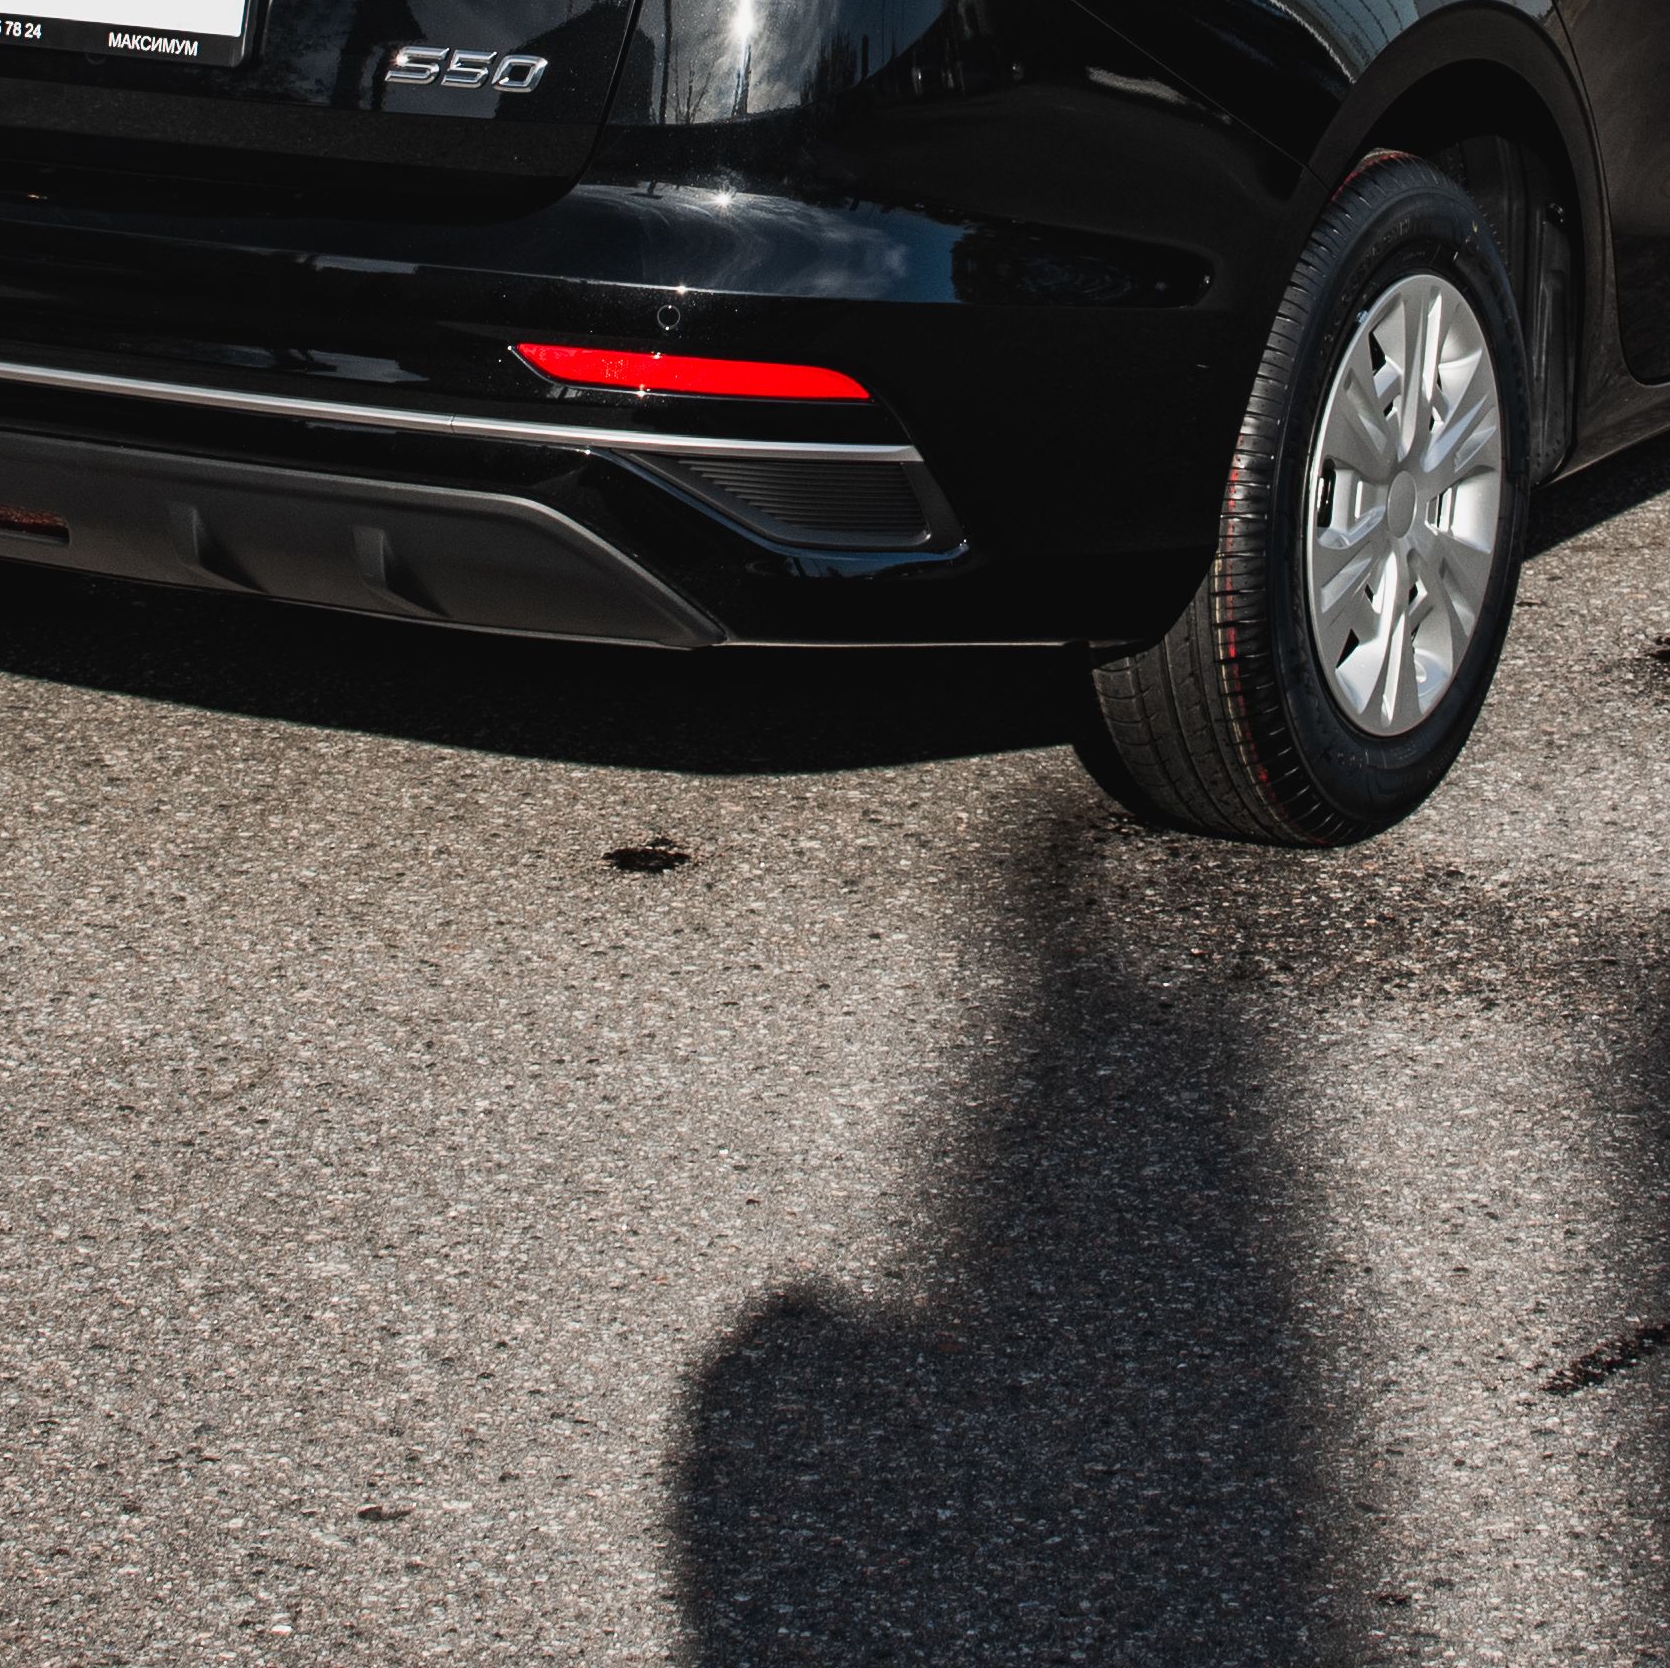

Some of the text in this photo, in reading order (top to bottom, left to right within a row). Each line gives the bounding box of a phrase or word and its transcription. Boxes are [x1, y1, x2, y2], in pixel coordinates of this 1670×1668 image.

[4, 21, 22, 37] 78
[24, 23, 42, 39] 24
[107, 31, 199, 57] МАКСИМУМ
[384, 45, 550, 94] S50
